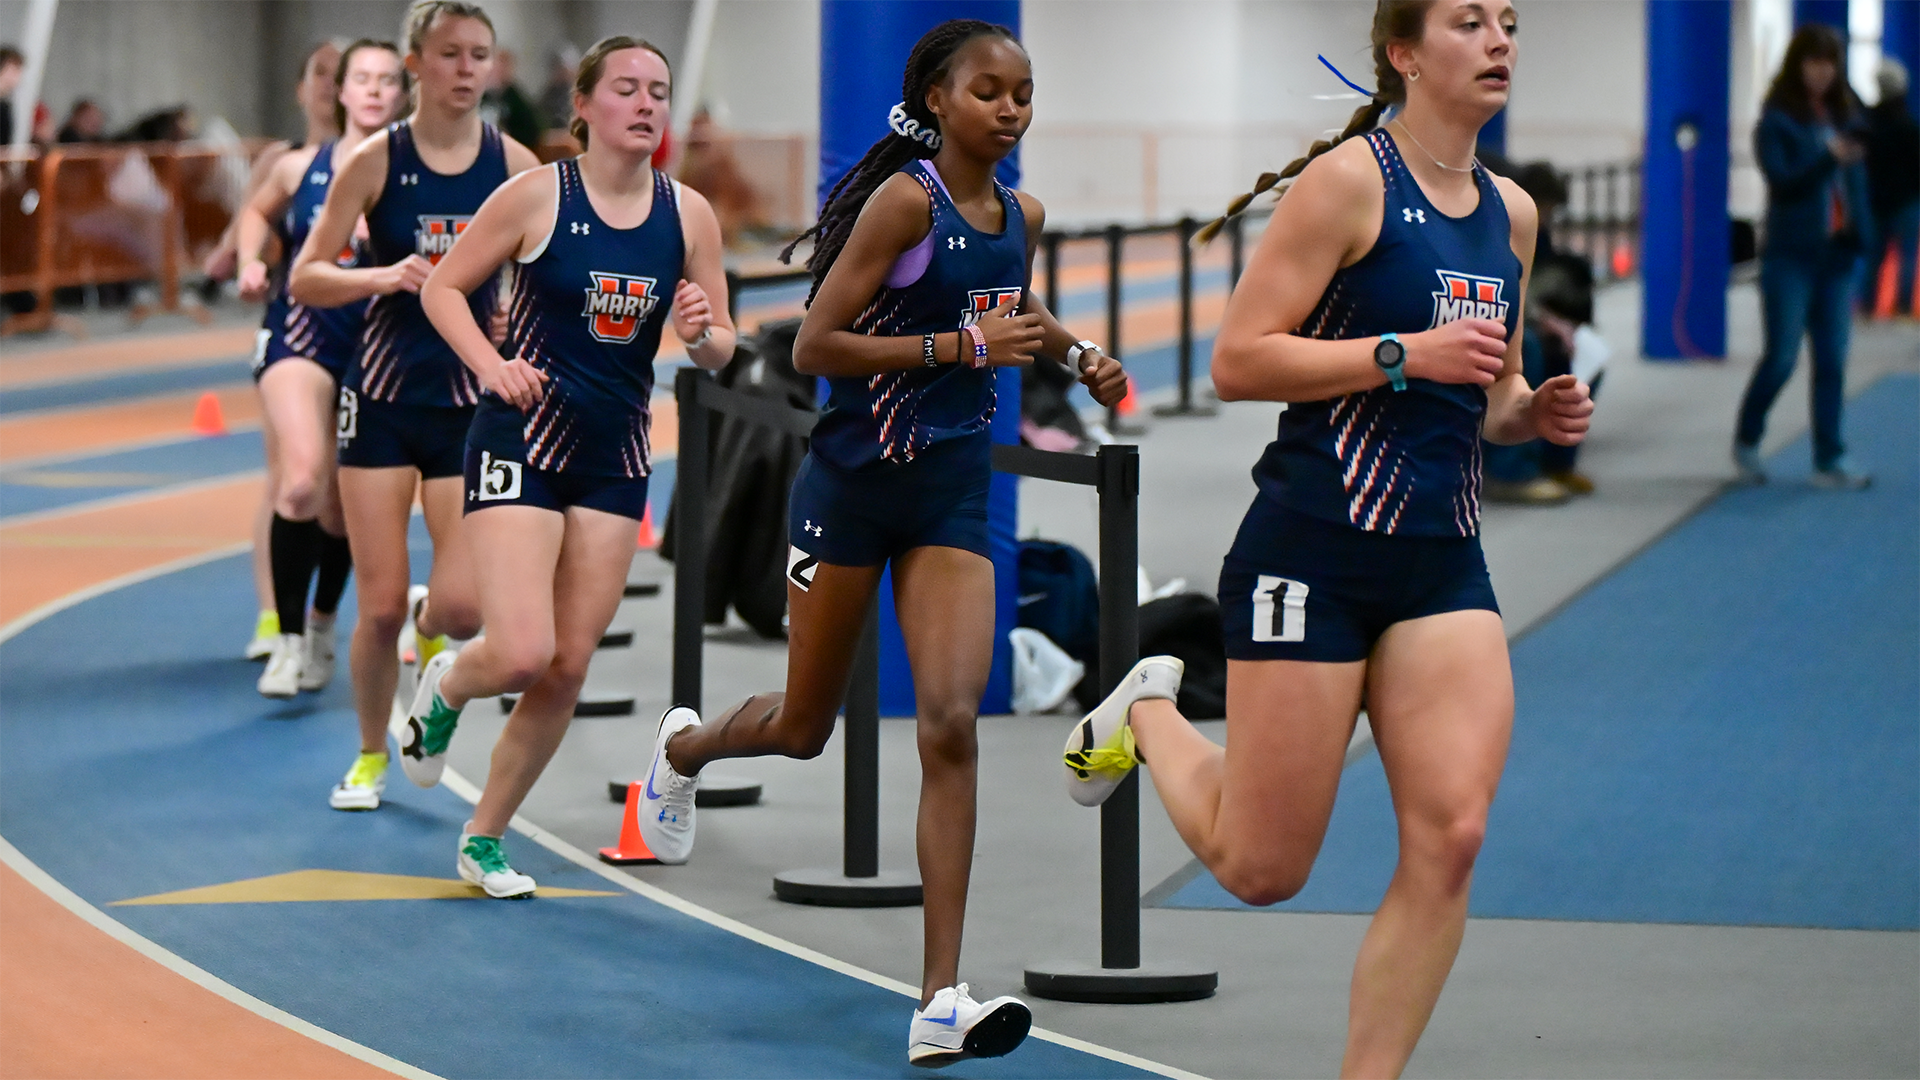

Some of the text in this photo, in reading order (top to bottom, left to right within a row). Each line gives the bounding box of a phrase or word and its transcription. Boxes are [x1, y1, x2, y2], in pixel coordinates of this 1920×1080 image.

[588, 292, 654, 318] MARY
[485, 456, 513, 495] 5
[1262, 581, 1289, 636] 1
